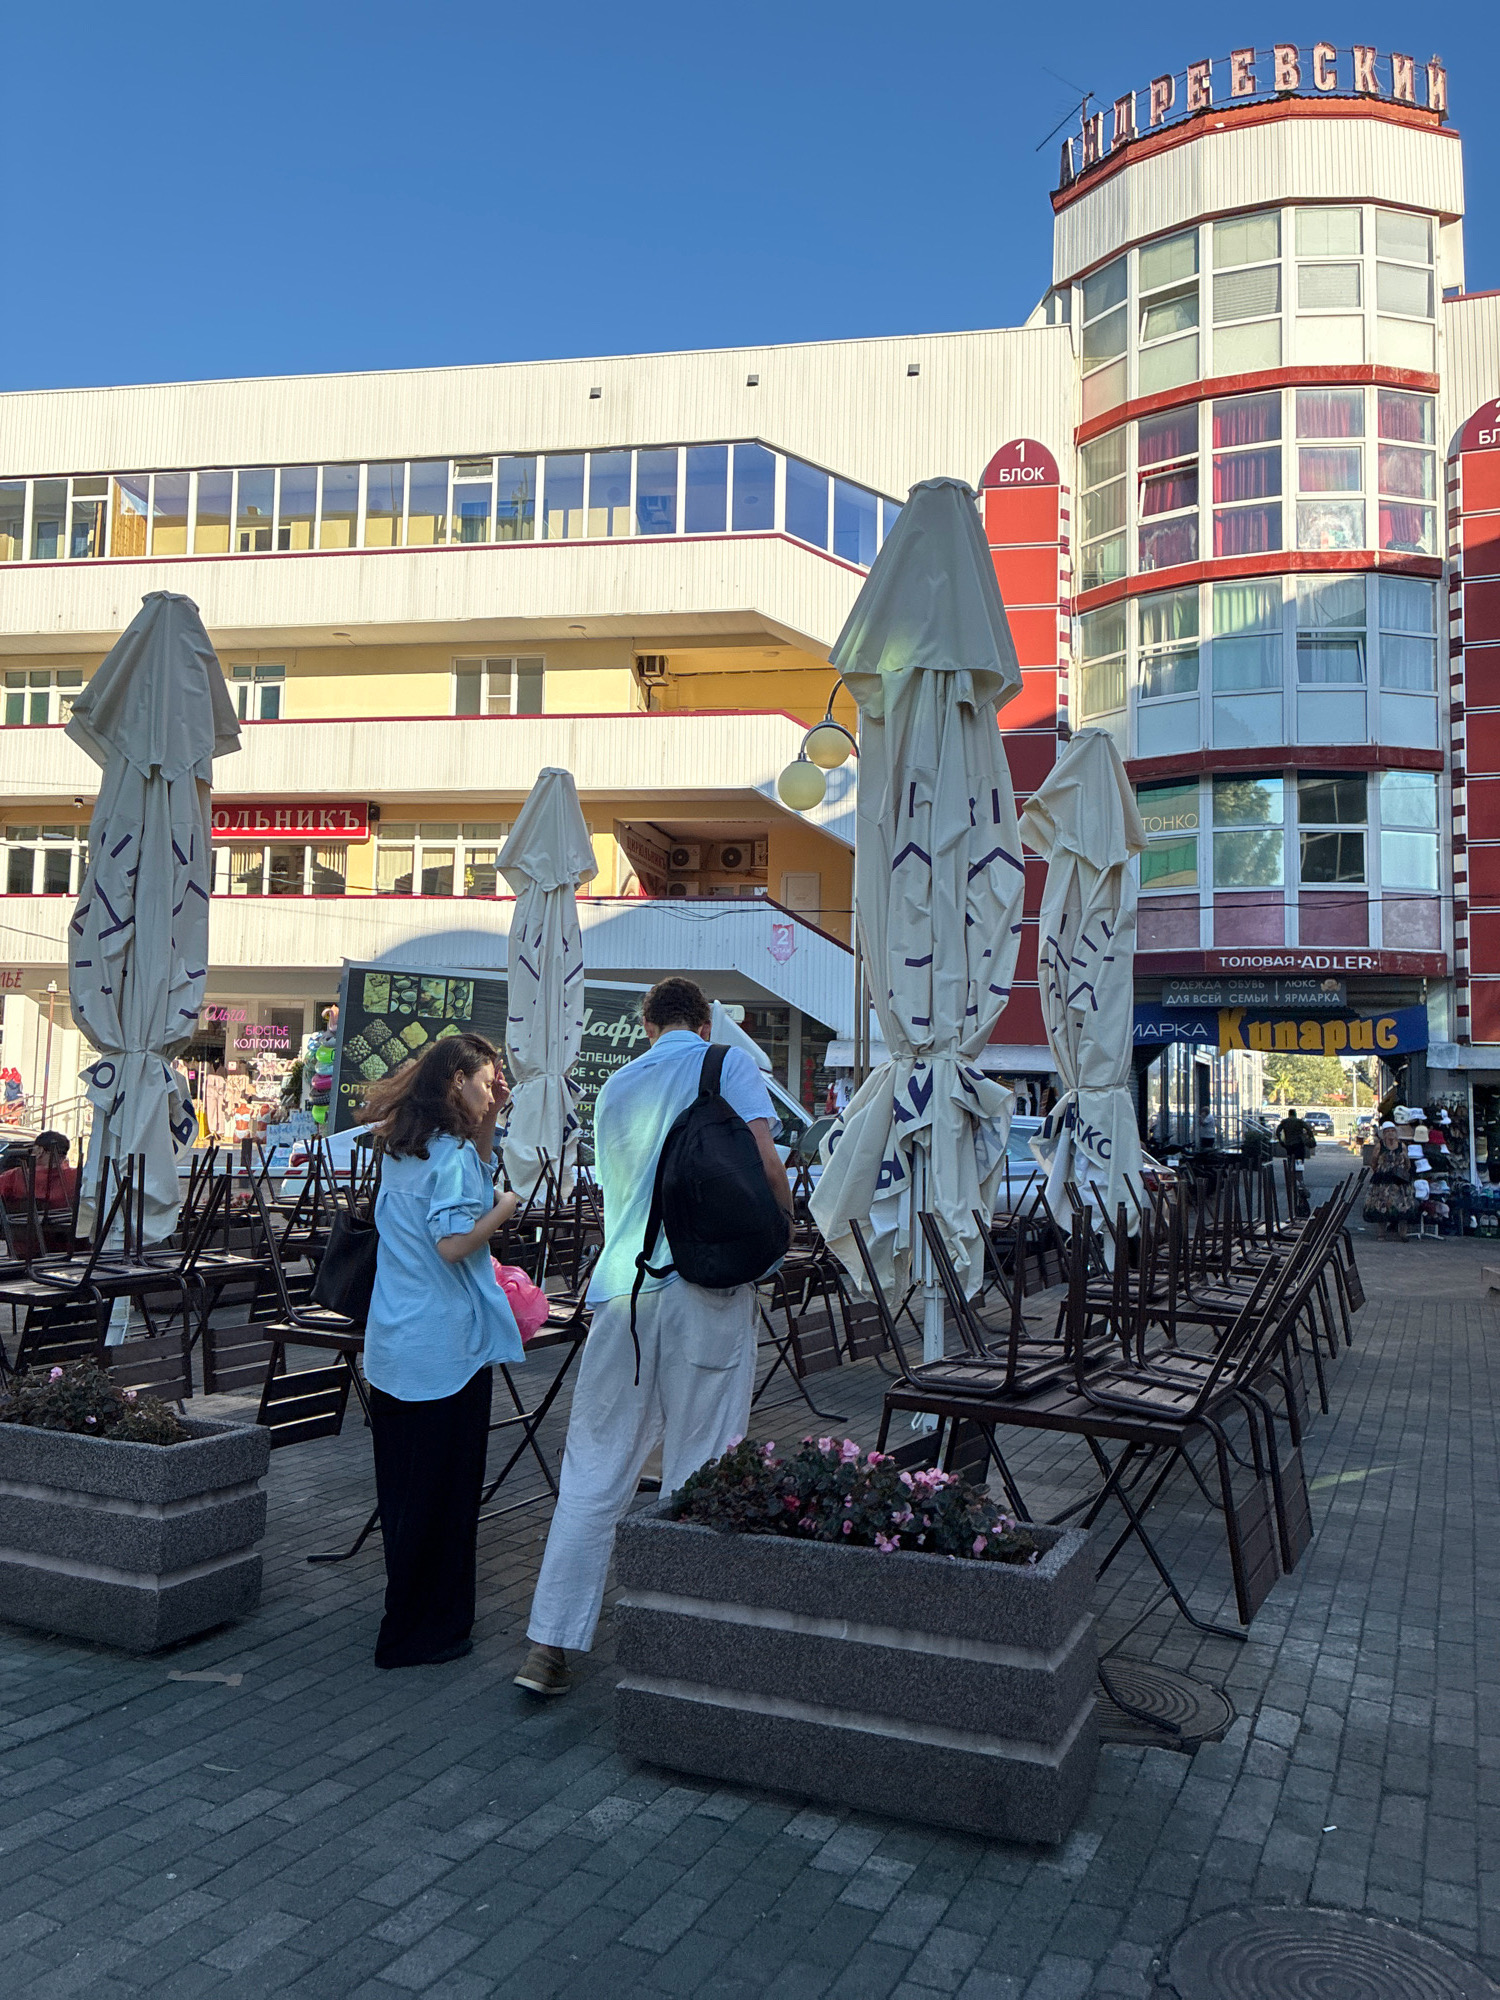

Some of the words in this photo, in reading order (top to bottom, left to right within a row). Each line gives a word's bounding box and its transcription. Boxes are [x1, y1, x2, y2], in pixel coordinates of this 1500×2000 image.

[1015, 441, 1025, 462] 1
[1000, 467, 1044, 482] БЛОК
[777, 928, 788, 945] 2
[1219, 956, 1295, 967] ТОЛОВАЯ
[1301, 956, 1372, 970] ADLER
[1170, 980, 1221, 990] ОДЕЖДА
[1228, 980, 1265, 989] ОБУВЬ
[1284, 979, 1316, 988] ЛЮКС
[1166, 995, 1189, 1004] ДЛЯ
[1193, 992, 1222, 1003] ВСЕЙ
[1229, 993, 1269, 1003] СЕМЬИ
[1284, 993, 1340, 1003] ЯРМАРКА
[204, 1003, 246, 1021] Ольга
[245, 1024, 289, 1036] БЮСТЬЕ
[1217, 1006, 1398, 1057] Кипарис
[233, 1038, 290, 1049] КОЛГОТКИ
